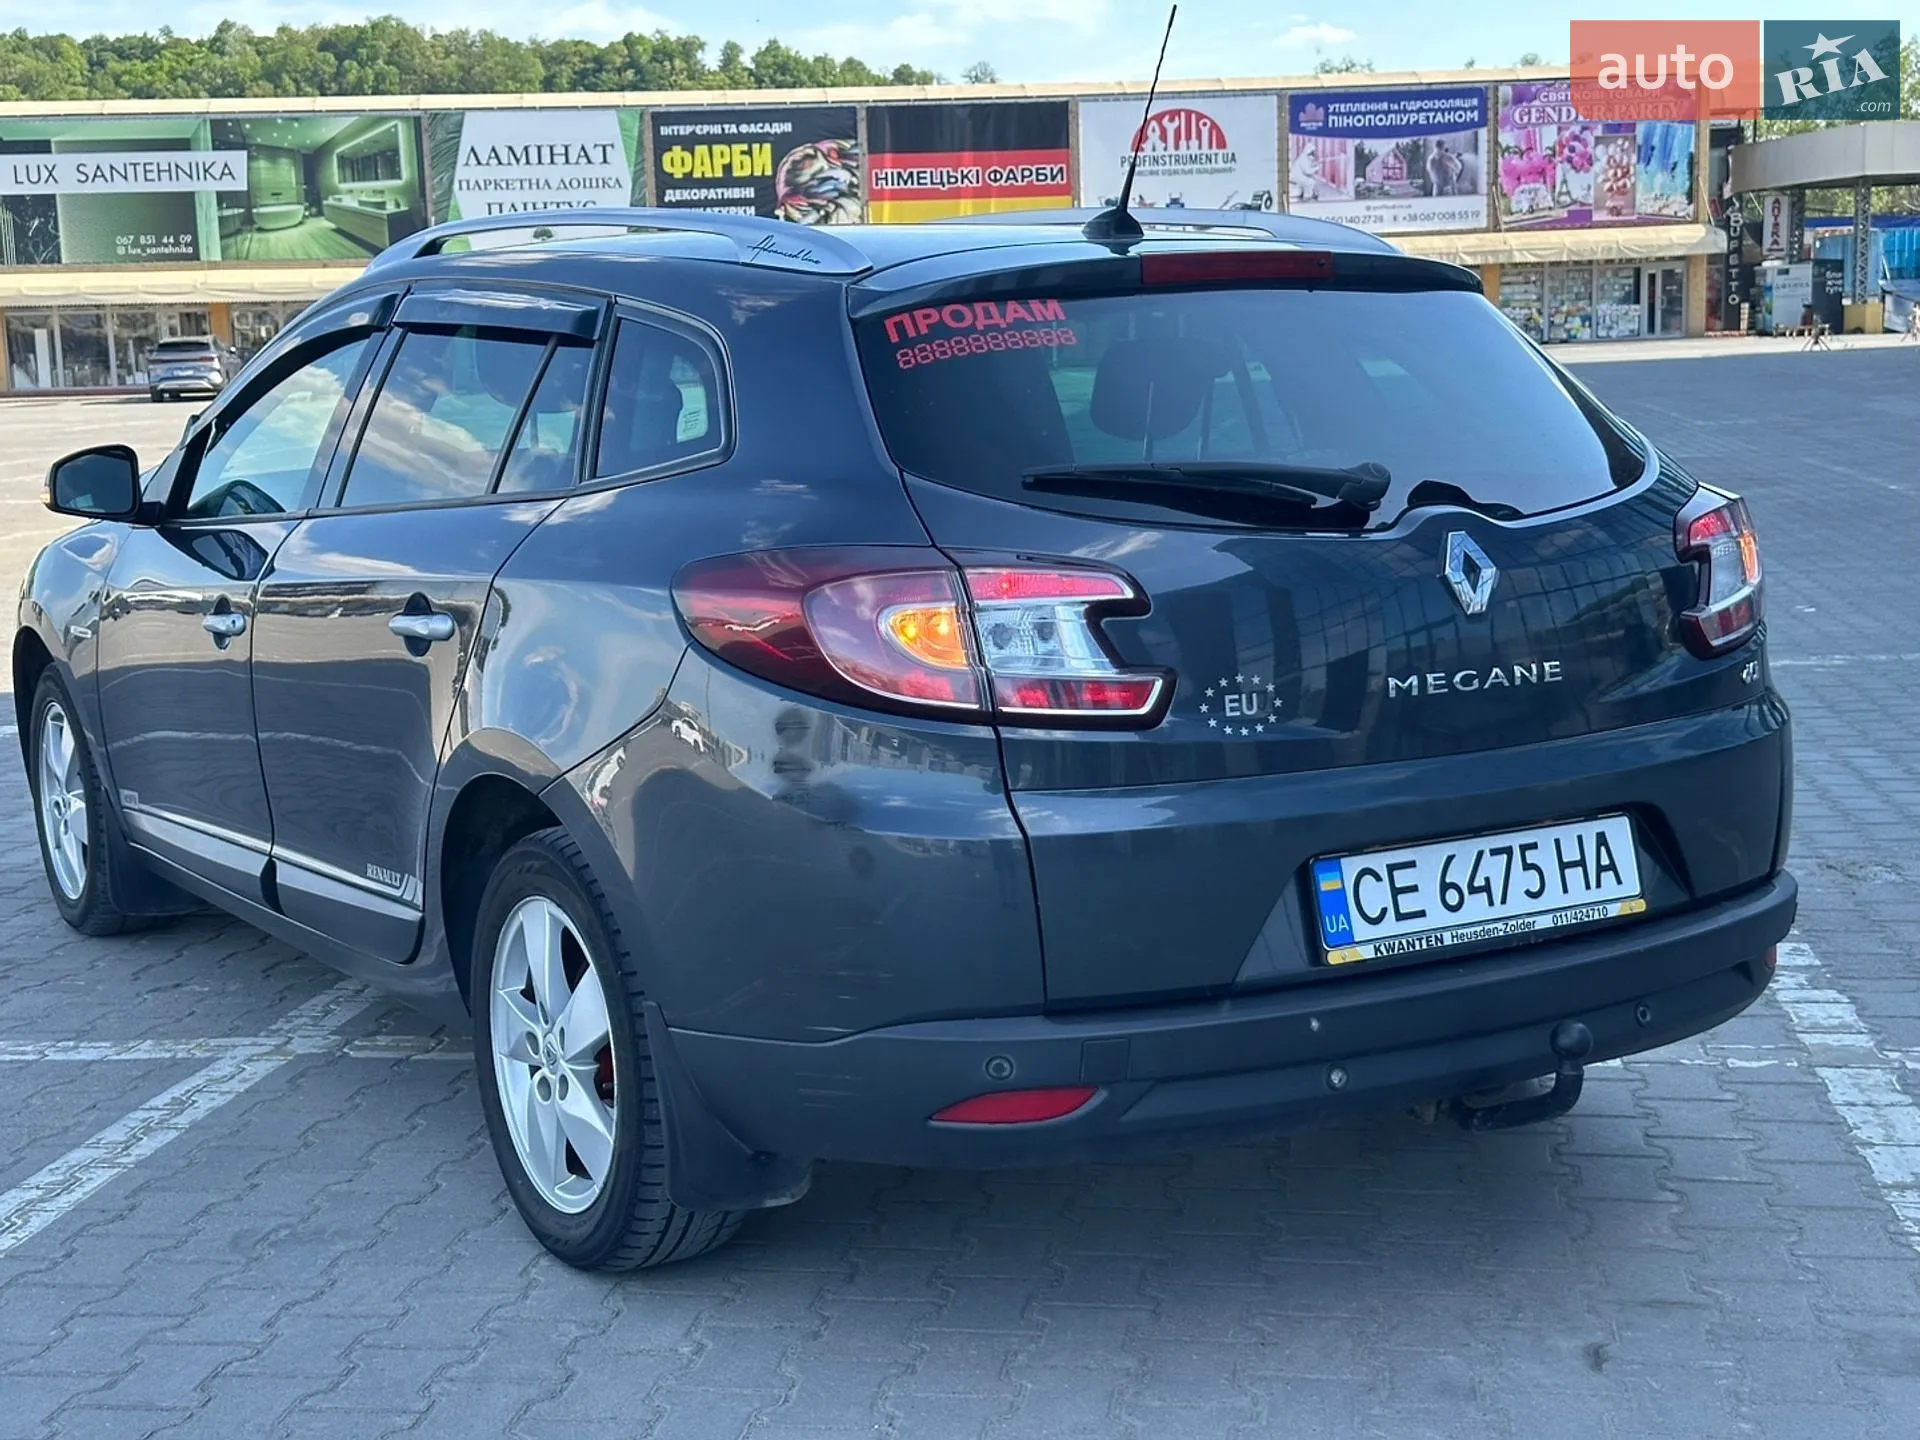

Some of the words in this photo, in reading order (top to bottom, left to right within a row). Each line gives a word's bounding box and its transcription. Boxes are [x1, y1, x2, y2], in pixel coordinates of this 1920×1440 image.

[1328, 101, 1388, 113] УТЕПЛЕННЯ
[1400, 97, 1478, 110] ГІДРОІЗОЛЯЦІЯ
[1513, 104, 1607, 125] GENDER
[722, 124, 738, 135] ТА
[738, 122, 792, 134] ФАСАДНІ
[1328, 110, 1479, 128] ПІНОПОЛІУРЕТАНОМ
[462, 143, 615, 167] ЛАМІНАТ
[661, 143, 773, 179] ФАРБИ
[1222, 152, 1237, 164] UA
[13, 163, 59, 185] LUX
[76, 160, 236, 184] SANTEHNIKA
[458, 178, 551, 191] ПАРКЕТНА
[555, 177, 623, 191] ДОШКА
[874, 167, 981, 189] НІМЕЦЬКІ
[985, 164, 1066, 185] ФАРБИ
[664, 187, 755, 202] ДЕКОРАТИВНІ
[115, 235, 134, 245] 067
[162, 235, 174, 244] 44
[179, 234, 192, 244] 09
[883, 299, 1067, 343] ПРОДАМ
[1386, 660, 1564, 698] MEGANE
[1223, 692, 1259, 718] EU
[366, 863, 401, 888] RENAULT
[1352, 859, 1427, 926] CE
[1437, 841, 1547, 914] 6475
[1553, 830, 1624, 894] HA
[1325, 914, 1350, 933] UA
[1373, 932, 1446, 957] KWANTEN
[1450, 918, 1537, 944] Heusden-Zolder
[1551, 905, 1609, 927] 011/424710
